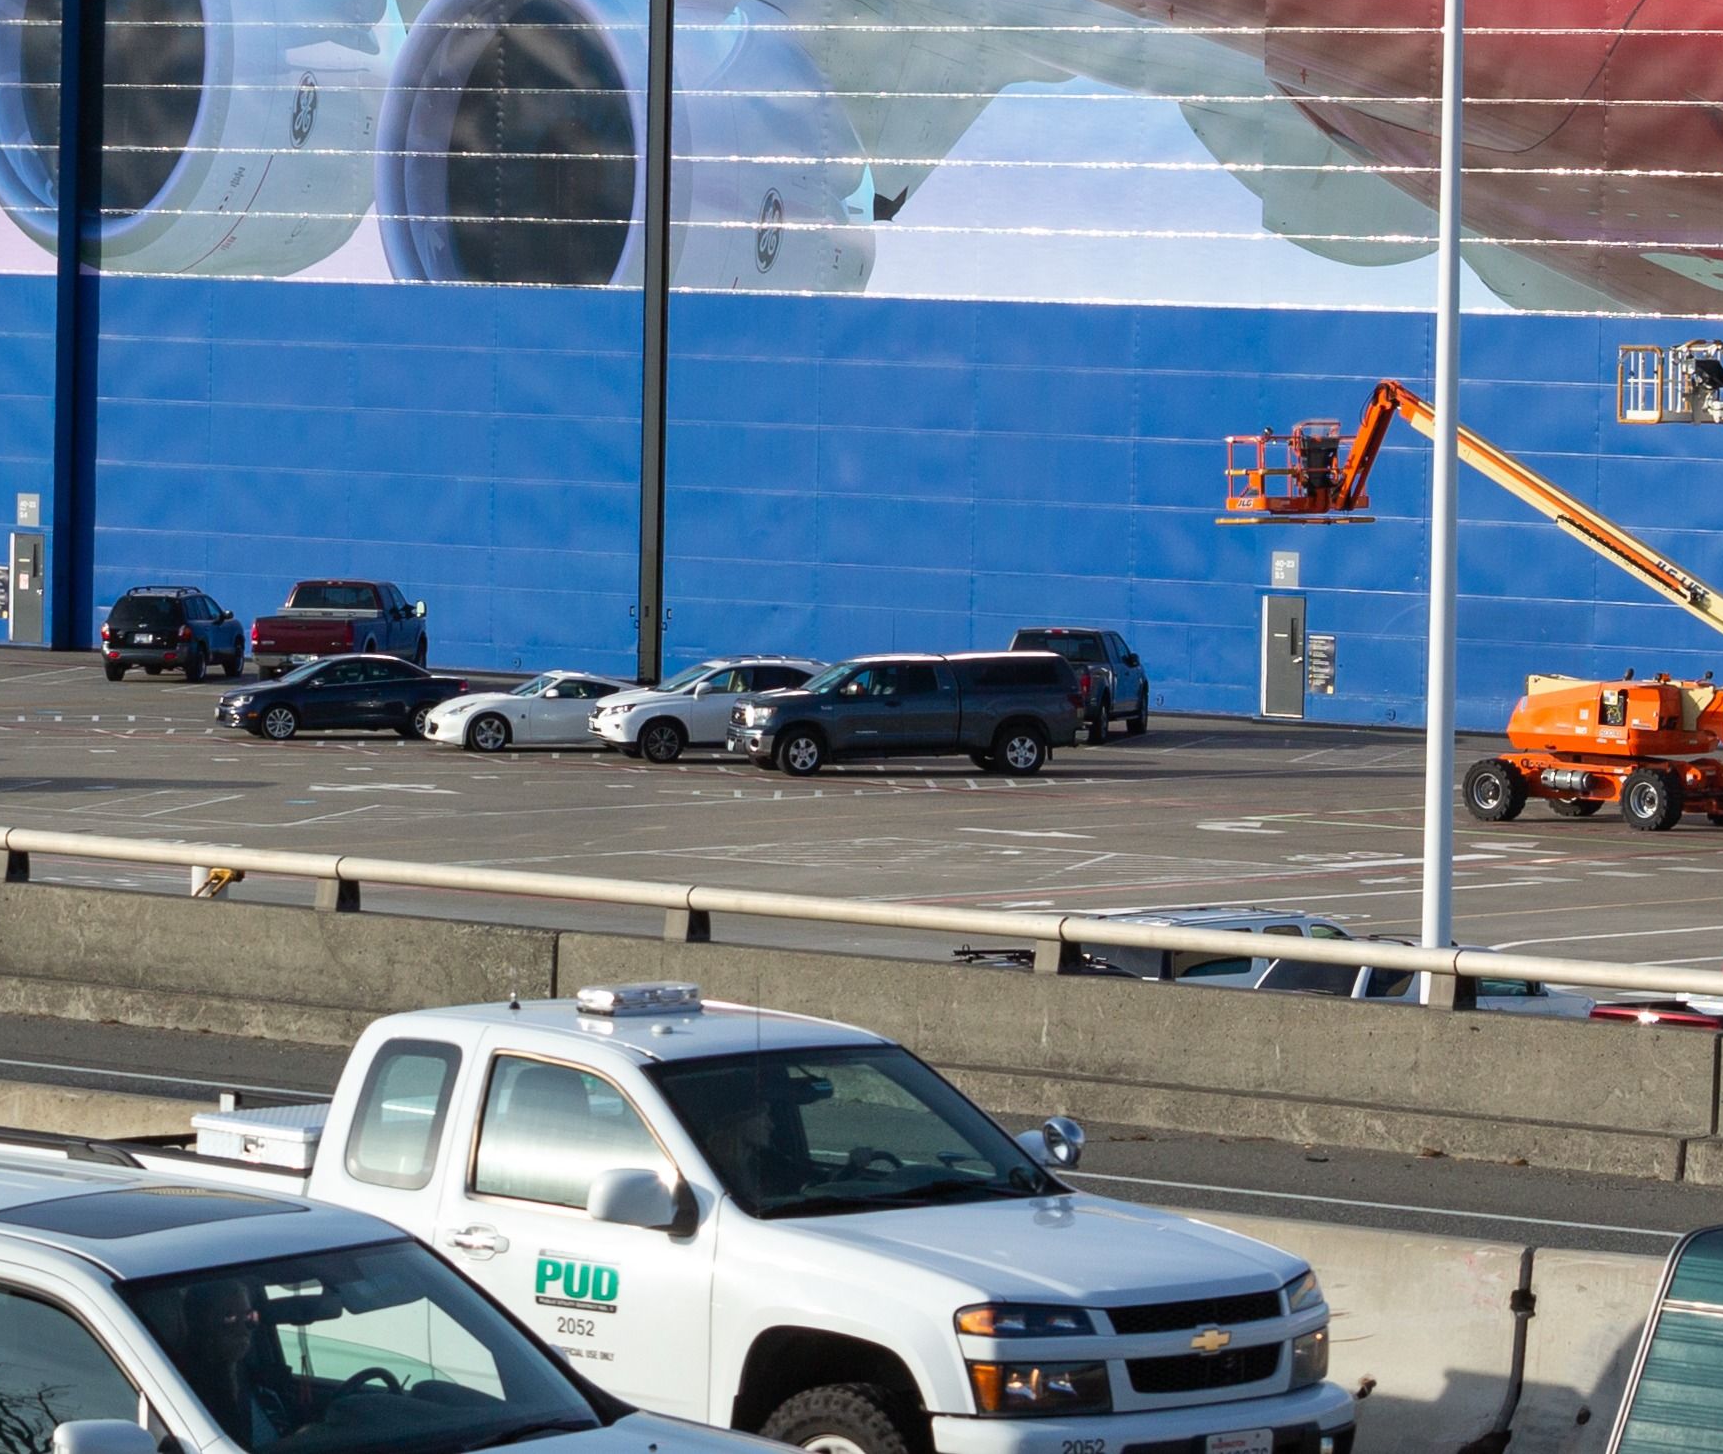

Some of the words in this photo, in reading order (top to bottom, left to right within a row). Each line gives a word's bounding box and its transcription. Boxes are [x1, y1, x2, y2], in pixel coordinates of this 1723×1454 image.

[1237, 498, 1254, 507] JLG
[535, 1257, 620, 1302] PUD
[557, 1316, 595, 1337] 2052
[1062, 1438, 1106, 1454] 2052
